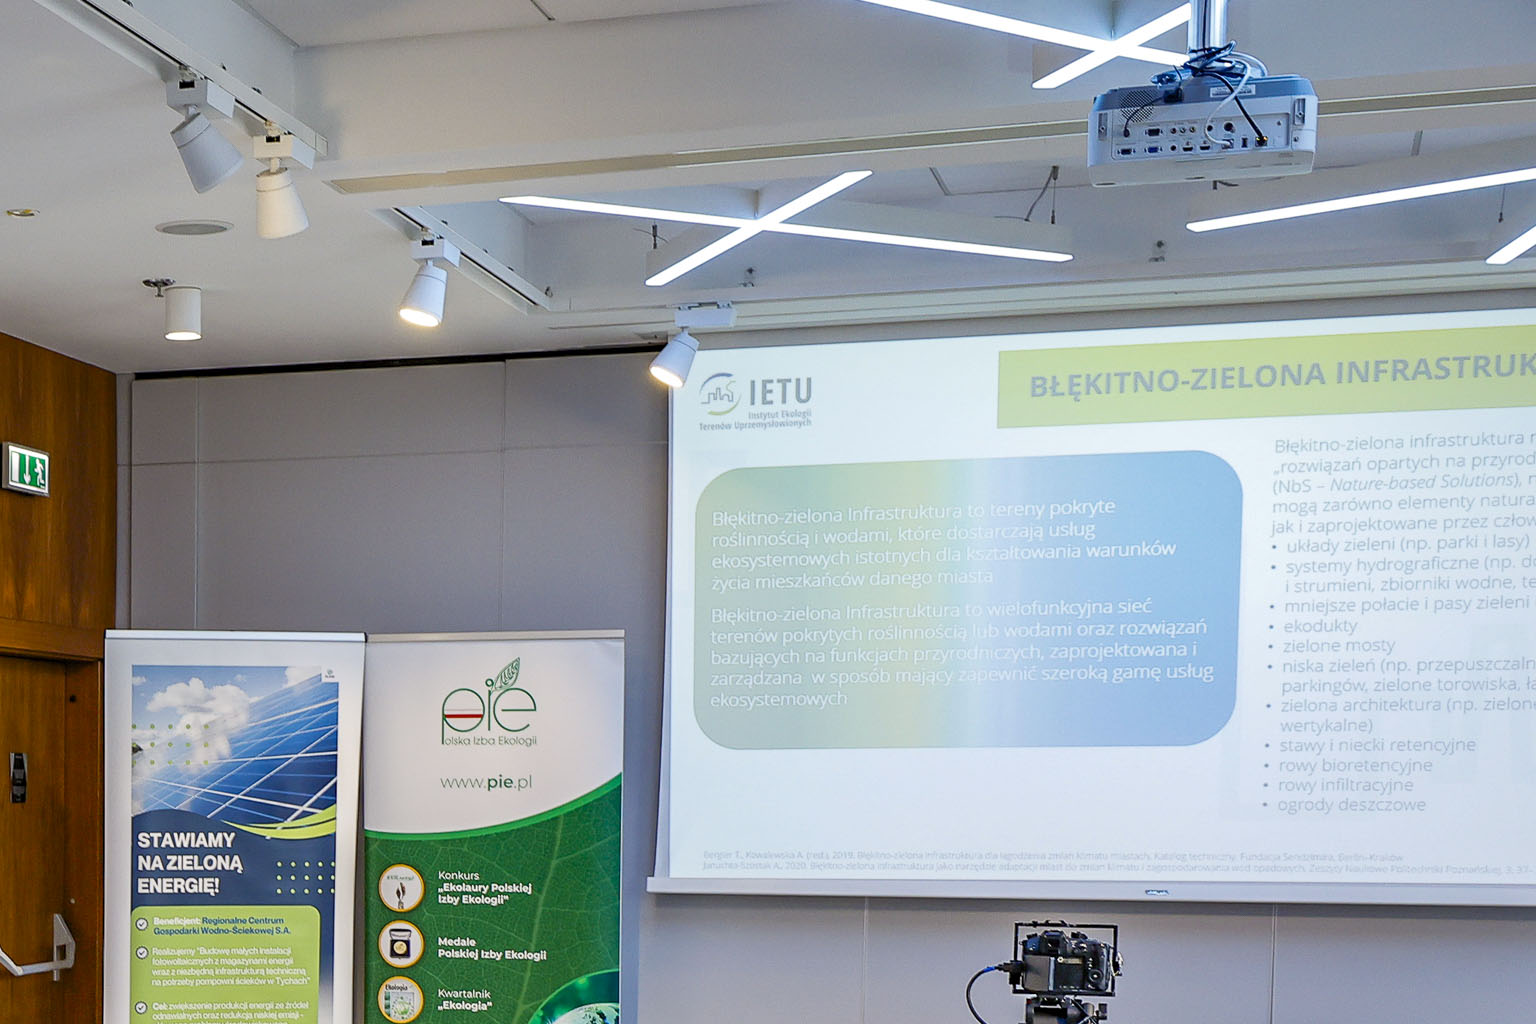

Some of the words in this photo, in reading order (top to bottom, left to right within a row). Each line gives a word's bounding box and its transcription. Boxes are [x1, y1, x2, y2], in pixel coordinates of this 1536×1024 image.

[1030, 361, 1325, 403] BŁĘKITNO-ZIELONA
[1336, 353, 1536, 385] INFRASTRUK
[749, 377, 812, 406] IETU
[748, 410, 779, 421] Instytut
[781, 409, 812, 420] Ekologii
[699, 421, 732, 431] Terenów
[735, 418, 812, 429] Uprzemysłowionych
[1275, 436, 1404, 455] Błękitno-zielona
[1410, 432, 1524, 449] infrastruktura
[1274, 458, 1361, 475] „rozwiązań
[1367, 454, 1440, 472] opartych
[1446, 457, 1465, 468] na
[1273, 479, 1311, 495] (NbS
[1331, 475, 1436, 492] Nature-based
[1441, 474, 1522, 489] Solutions),
[712, 509, 842, 529] Błękitno-zielona
[848, 505, 961, 522] Infrastruktura
[969, 504, 985, 517] to
[990, 504, 1045, 518] tereny
[1050, 500, 1116, 520] pokryte
[1273, 502, 1317, 516] mogą
[1323, 496, 1392, 513] zarówno
[1398, 495, 1475, 514] elementy
[712, 530, 809, 549] roślinnością
[824, 529, 893, 544] wodami,
[897, 527, 942, 542] które
[947, 524, 1043, 542] dostarczają
[1049, 522, 1096, 540] usług
[1270, 520, 1293, 538] jak
[1308, 516, 1438, 535] zaprojektowane
[1444, 516, 1487, 532] przez
[1287, 540, 1339, 555] układy
[1344, 538, 1395, 552] zieleni
[1400, 538, 1431, 553] (np.
[1438, 535, 1477, 552] parki
[1493, 534, 1530, 550] lasy)
[712, 551, 849, 571] ekosystemowych
[856, 548, 930, 566] istotnych
[936, 547, 960, 562] dla
[967, 544, 1081, 561] kształtowania
[1086, 539, 1176, 558] warunków
[1286, 559, 1351, 576] systemy
[1357, 555, 1479, 573] hydrograficzne
[1485, 555, 1511, 572] (np.
[712, 576, 750, 593] życia
[755, 572, 864, 589] mieszkańców
[870, 570, 932, 588] danego
[938, 569, 993, 584] miasta
[1294, 577, 1375, 593] strumieni,
[1381, 576, 1450, 592] zbiorniki
[1456, 575, 1516, 591] wodne,
[712, 605, 840, 625] Błękitno-zielona
[847, 604, 960, 619] Infrastruktura
[966, 603, 982, 616] to
[988, 599, 1112, 618] wielofunkcyjna
[1119, 597, 1152, 614] sieć
[1285, 598, 1355, 617] mniejsze
[1362, 596, 1419, 616] połacie
[1435, 598, 1472, 613] pasy
[1477, 594, 1530, 610] zieleni
[711, 628, 777, 645] terenów
[783, 626, 862, 646] pokrytych
[868, 624, 967, 641] roślinnością
[972, 624, 999, 638] lub
[1005, 621, 1071, 637] wodami
[1077, 623, 1114, 636] oraz
[1120, 619, 1207, 638] rozwiązań
[1284, 619, 1358, 636] ekodukty
[712, 648, 799, 669] bazujących
[805, 651, 825, 664] na
[831, 647, 908, 665] funkcjach
[1050, 641, 1187, 661] zaprojektowana
[1283, 641, 1341, 653] zielone
[1346, 640, 1395, 655] mosty
[1283, 660, 1323, 673] niska
[1329, 659, 1375, 673] zieleń
[1381, 659, 1411, 674] (np.
[711, 671, 802, 689] zarządzana
[811, 673, 825, 683] w
[830, 668, 889, 687] sposób
[896, 669, 952, 685] mający
[959, 666, 1036, 684] zapewnić
[1042, 664, 1108, 683] szeroką
[1112, 665, 1161, 683] gamę
[1166, 663, 1214, 682] usług
[1282, 679, 1368, 696] parkingów,
[1374, 678, 1432, 692] zielone
[1438, 676, 1520, 692] torowiska,
[712, 692, 848, 711] ekosystemowych
[1281, 699, 1338, 712] zielona
[1343, 698, 1441, 712] architektura
[1447, 698, 1477, 714] (np.
[1281, 719, 1373, 735] wertykalne)
[474, 737, 495, 745] Izba
[499, 736, 536, 747] Ekologii
[1280, 740, 1325, 756] stawy
[1339, 739, 1384, 752] niecki
[1390, 739, 1476, 755] retencyjne
[1279, 761, 1317, 775] rowy
[1323, 759, 1433, 775] bioretencyjne
[440, 774, 532, 791] www.pie.pl
[1279, 781, 1316, 795] rowy
[1322, 778, 1414, 796] infiltracyjne
[1278, 799, 1333, 815] ogrody
[1339, 798, 1426, 812] deszczowe
[137, 832, 235, 847] STAWIAMY
[137, 855, 165, 871] NA
[166, 855, 244, 873] ZIELONĄ
[439, 871, 479, 880] Konkurs
[137, 878, 220, 896] ENERGIĘ!
[438, 883, 488, 894] „Ekolaury
[491, 883, 531, 894] Polskiej
[439, 895, 459, 905] Izby
[153, 917, 201, 926] Beneficjent:
[202, 917, 247, 926] Regionalne
[154, 927, 199, 935] Gospodarki
[201, 927, 274, 935] Wodno-Ściekowej
[438, 937, 476, 946] Medale
[438, 949, 478, 959] Polskiej
[481, 950, 502, 960] Izby
[505, 950, 546, 962] Ekologii
[438, 989, 491, 998] Kwartalnik
